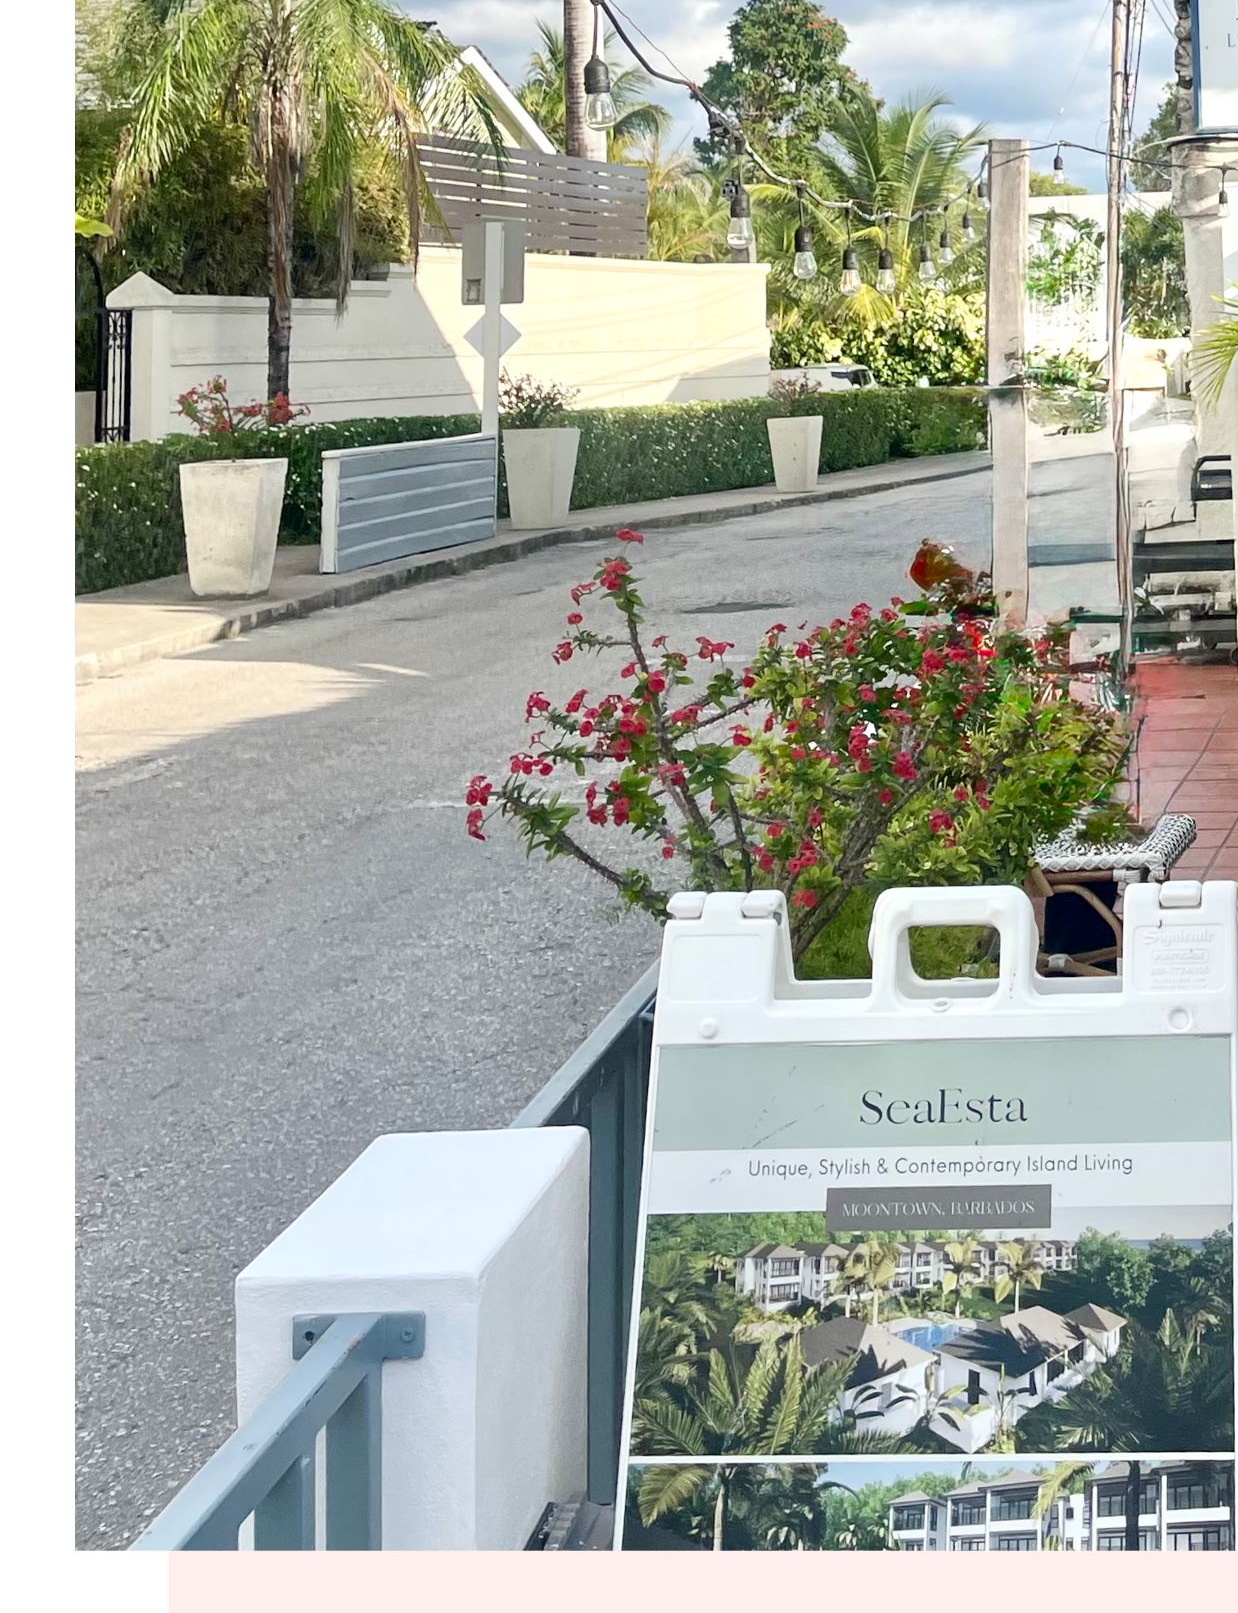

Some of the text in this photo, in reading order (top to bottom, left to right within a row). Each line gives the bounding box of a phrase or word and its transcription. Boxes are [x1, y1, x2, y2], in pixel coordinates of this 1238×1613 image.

[859, 1088, 1029, 1126] SeaEsta
[748, 1153, 1134, 1180] Unique, Stylish & Contemporary Island Living
[841, 1199, 1036, 1217] MOONTOWN, BARBADOS
